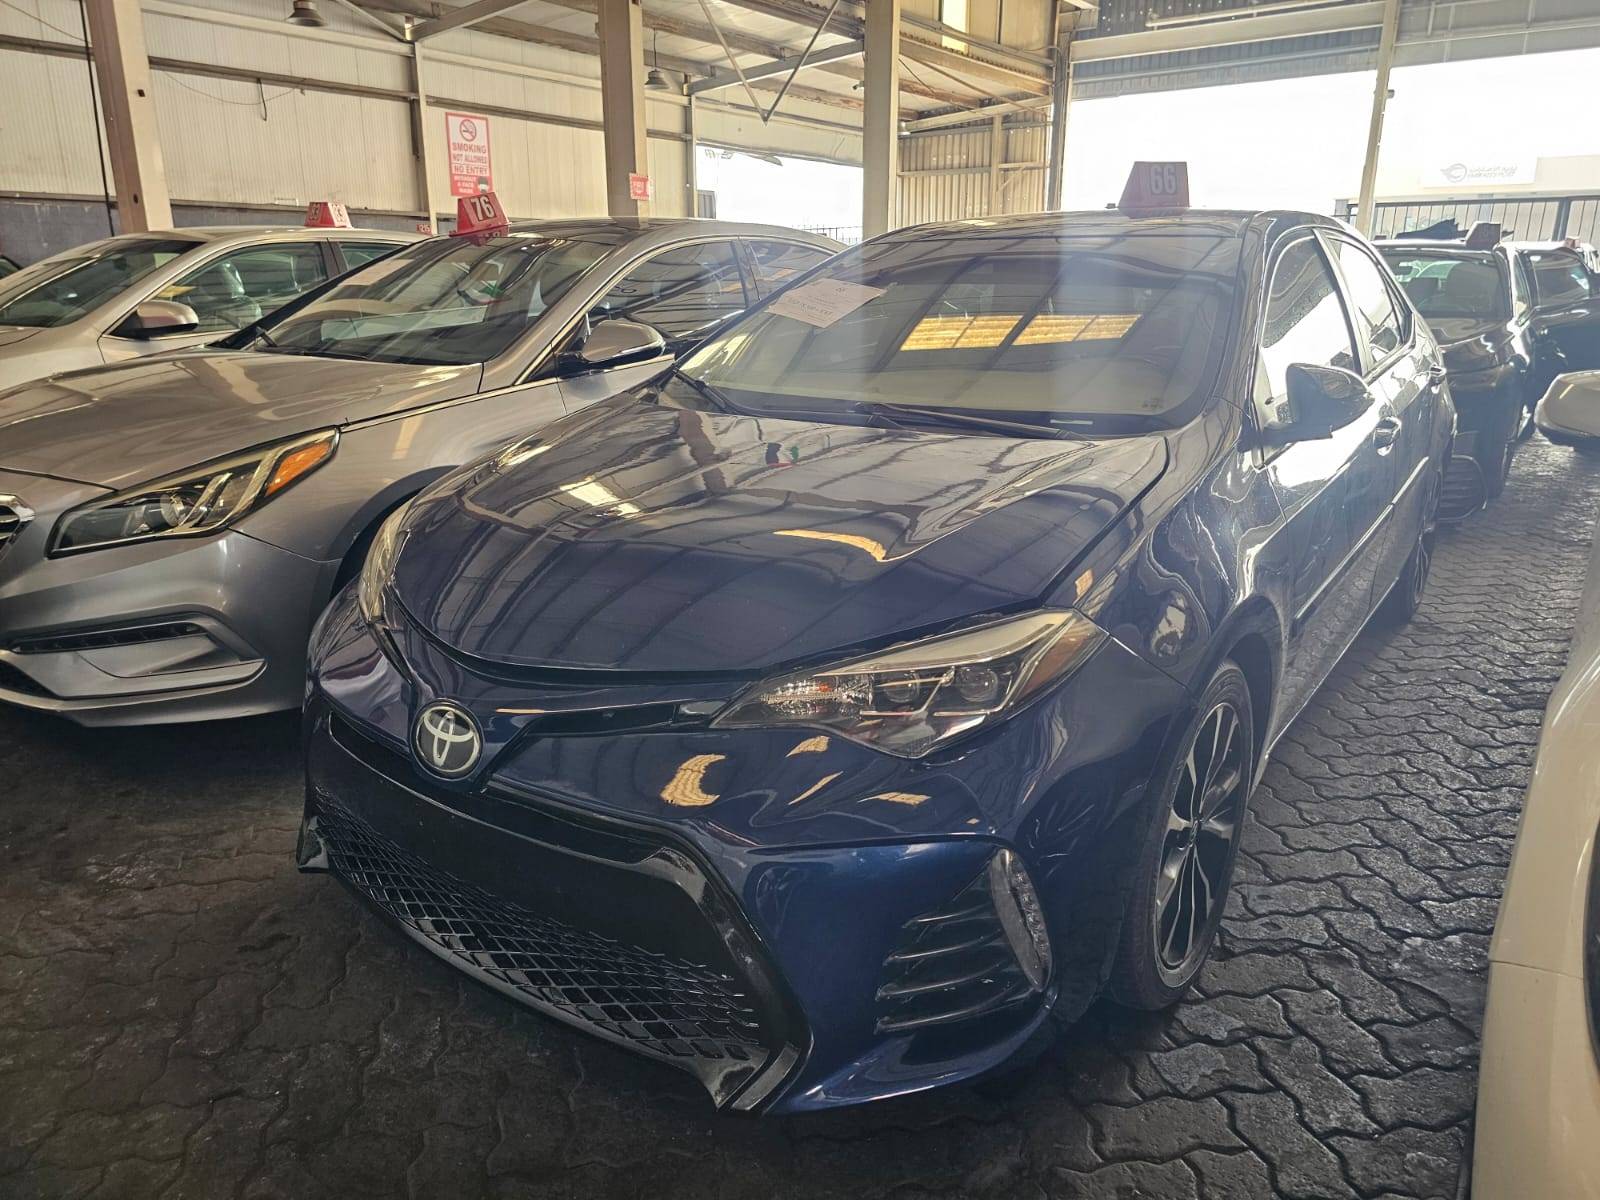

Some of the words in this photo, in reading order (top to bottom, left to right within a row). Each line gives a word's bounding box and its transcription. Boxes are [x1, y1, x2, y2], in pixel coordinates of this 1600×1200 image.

[452, 142, 487, 154] SMOKING
[452, 153, 463, 162] NOT
[454, 164, 465, 173] NO
[466, 165, 488, 175] ENTRY
[1151, 164, 1177, 194] 66
[471, 196, 495, 221] 76
